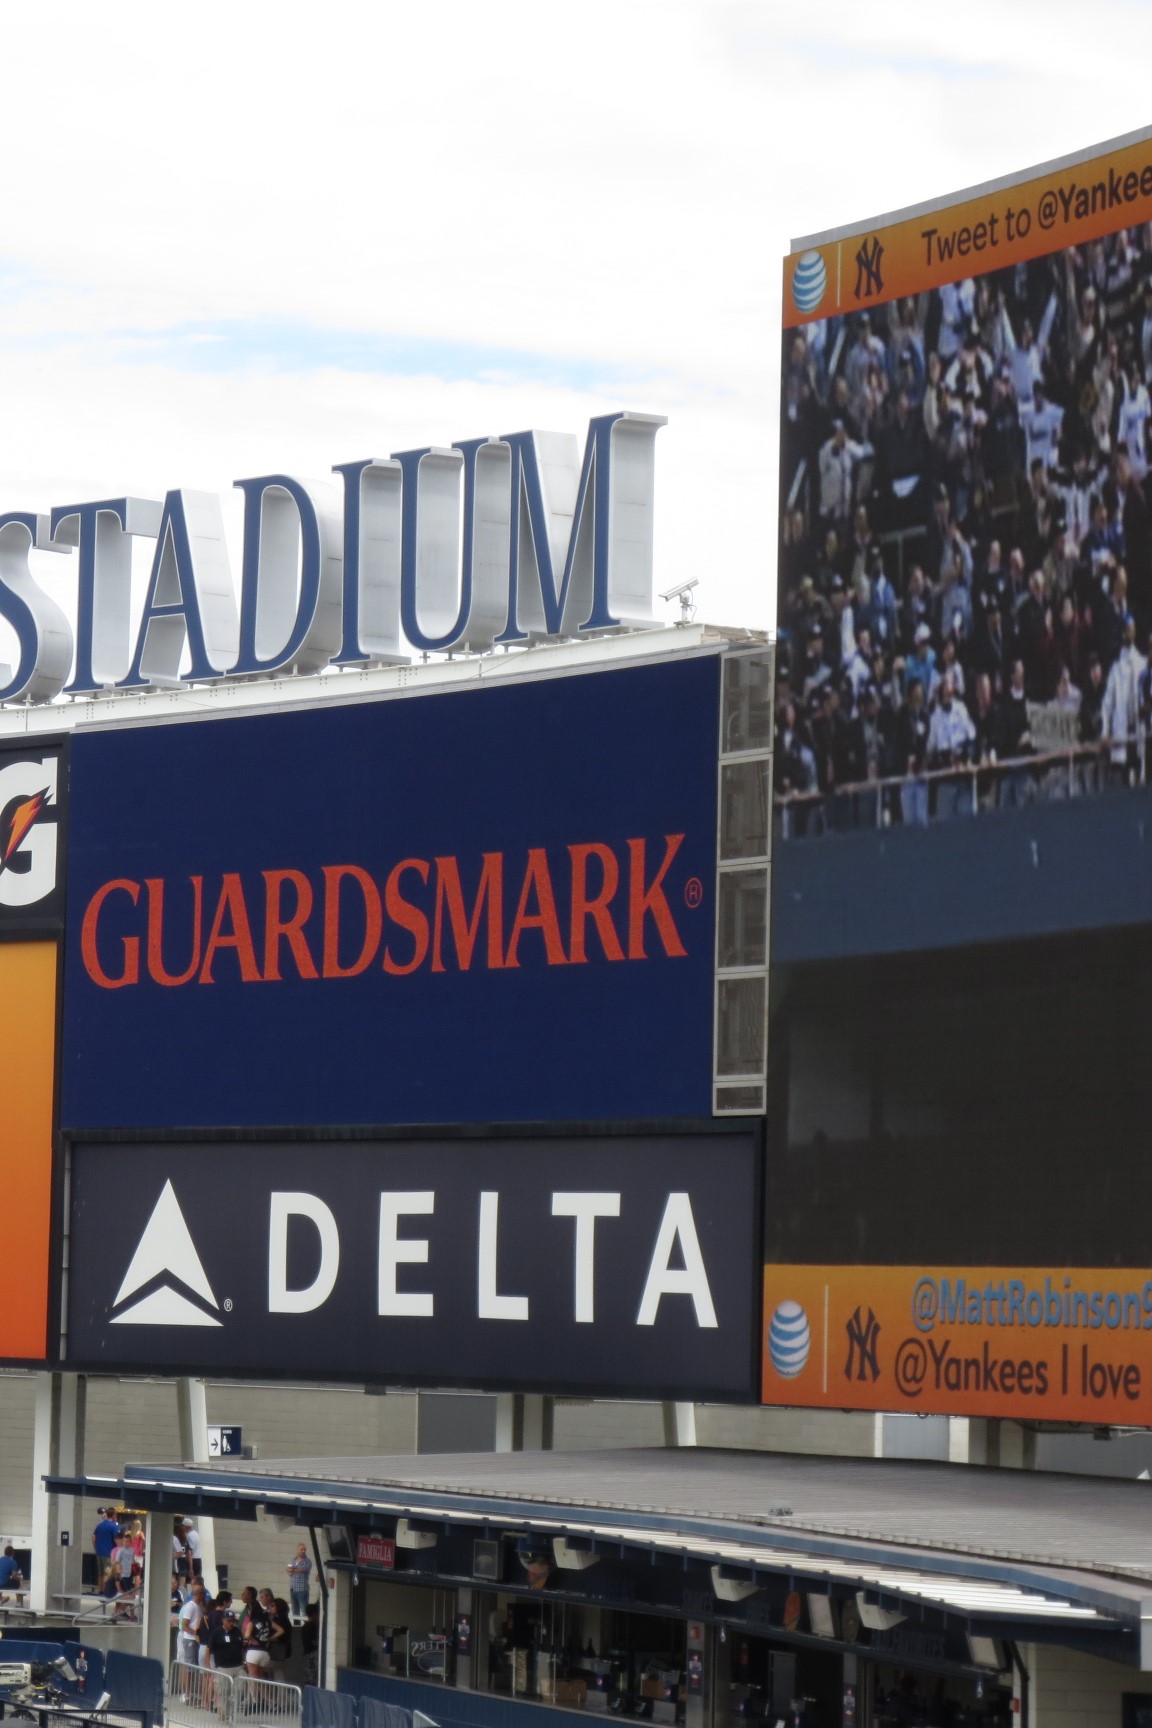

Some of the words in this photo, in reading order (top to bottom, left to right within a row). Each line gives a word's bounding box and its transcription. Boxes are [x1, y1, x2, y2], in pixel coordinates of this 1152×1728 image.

[921, 213, 999, 267] Tweet
[1005, 207, 1032, 242] to
[80, 833, 689, 989] GUARDSMARK
[268, 1190, 719, 1328] DELTA
[895, 1337, 1048, 1398] @Yankees
[1061, 1343, 1069, 1396] I
[1081, 1343, 1141, 1400] love
